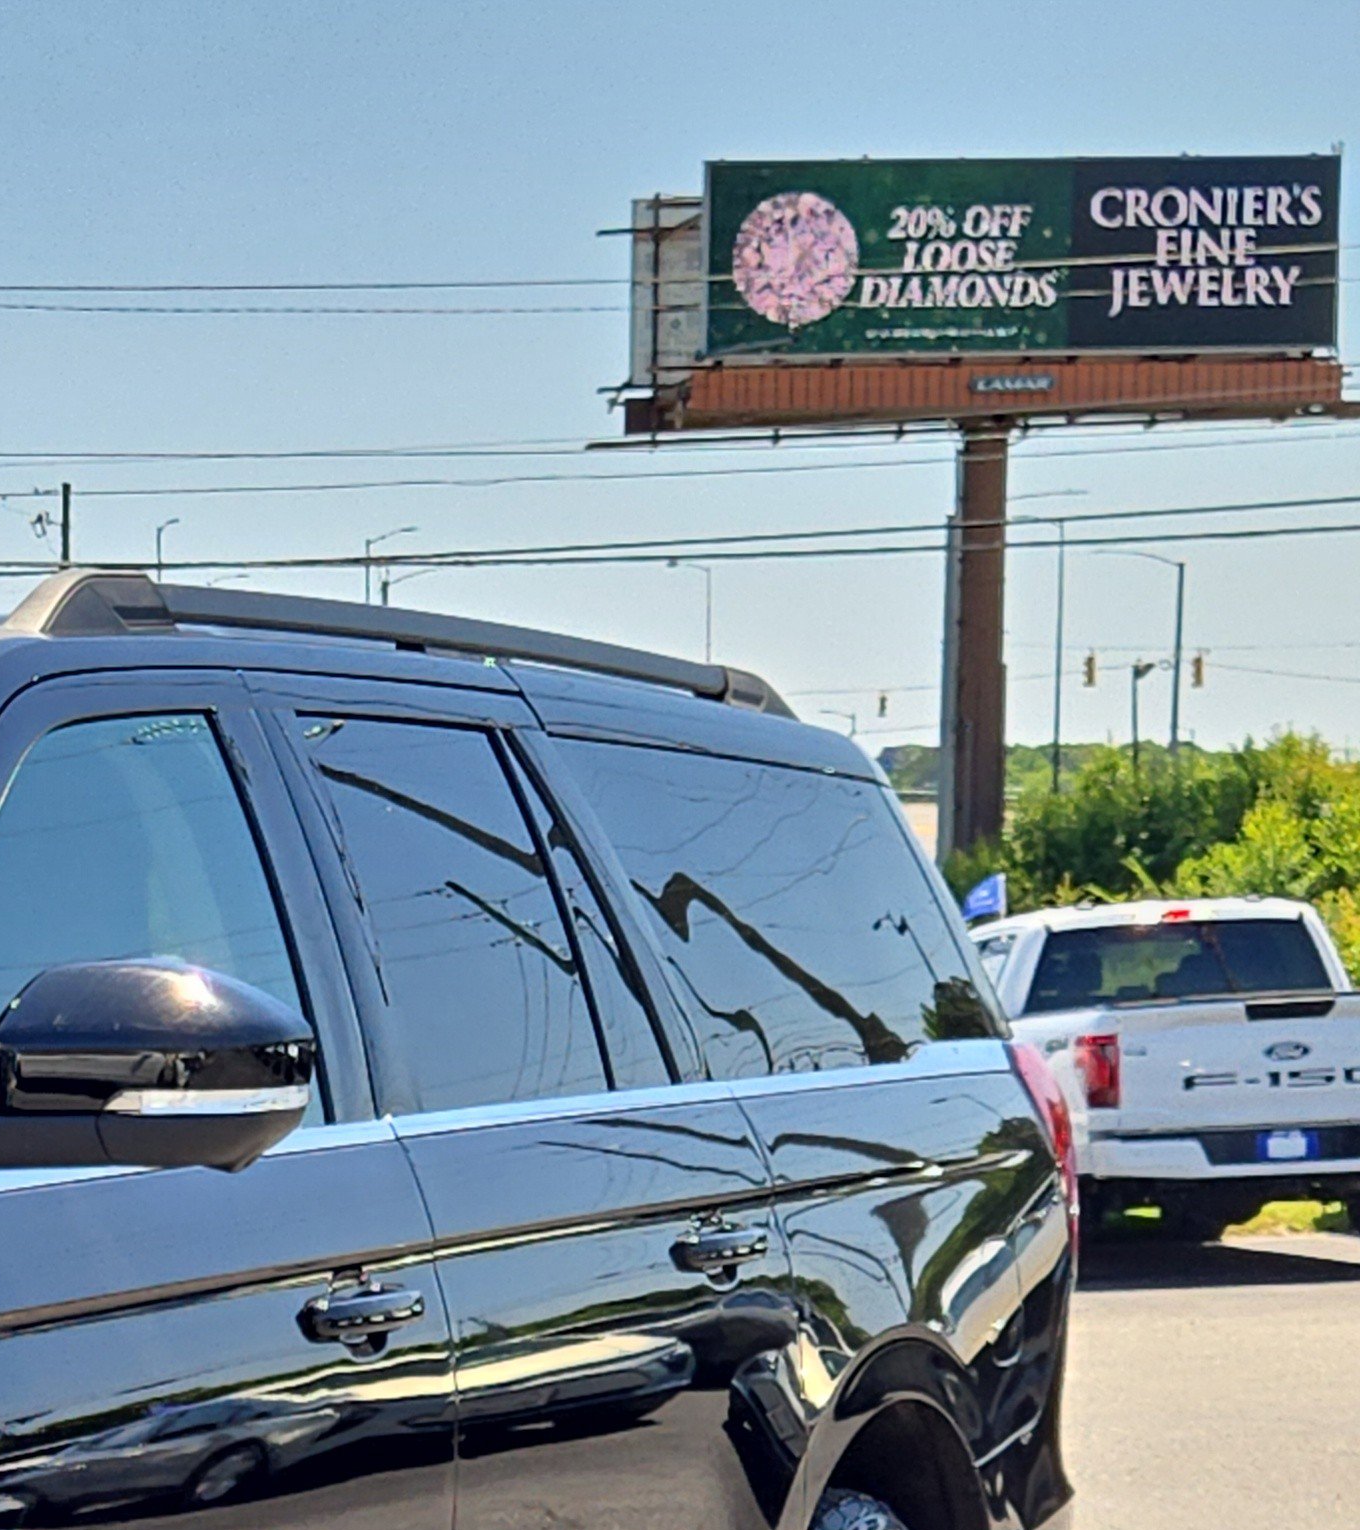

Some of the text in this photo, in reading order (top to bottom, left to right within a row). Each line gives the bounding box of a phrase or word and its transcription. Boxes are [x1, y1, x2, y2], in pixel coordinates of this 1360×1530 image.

[886, 203, 1034, 240] 20% OFF
[1090, 183, 1323, 228] CRONIER'S
[903, 239, 1018, 273] LOOSE
[1155, 228, 1258, 267] FINE
[858, 272, 1058, 308] DIAMONDS
[1108, 265, 1301, 318] JEWELRY
